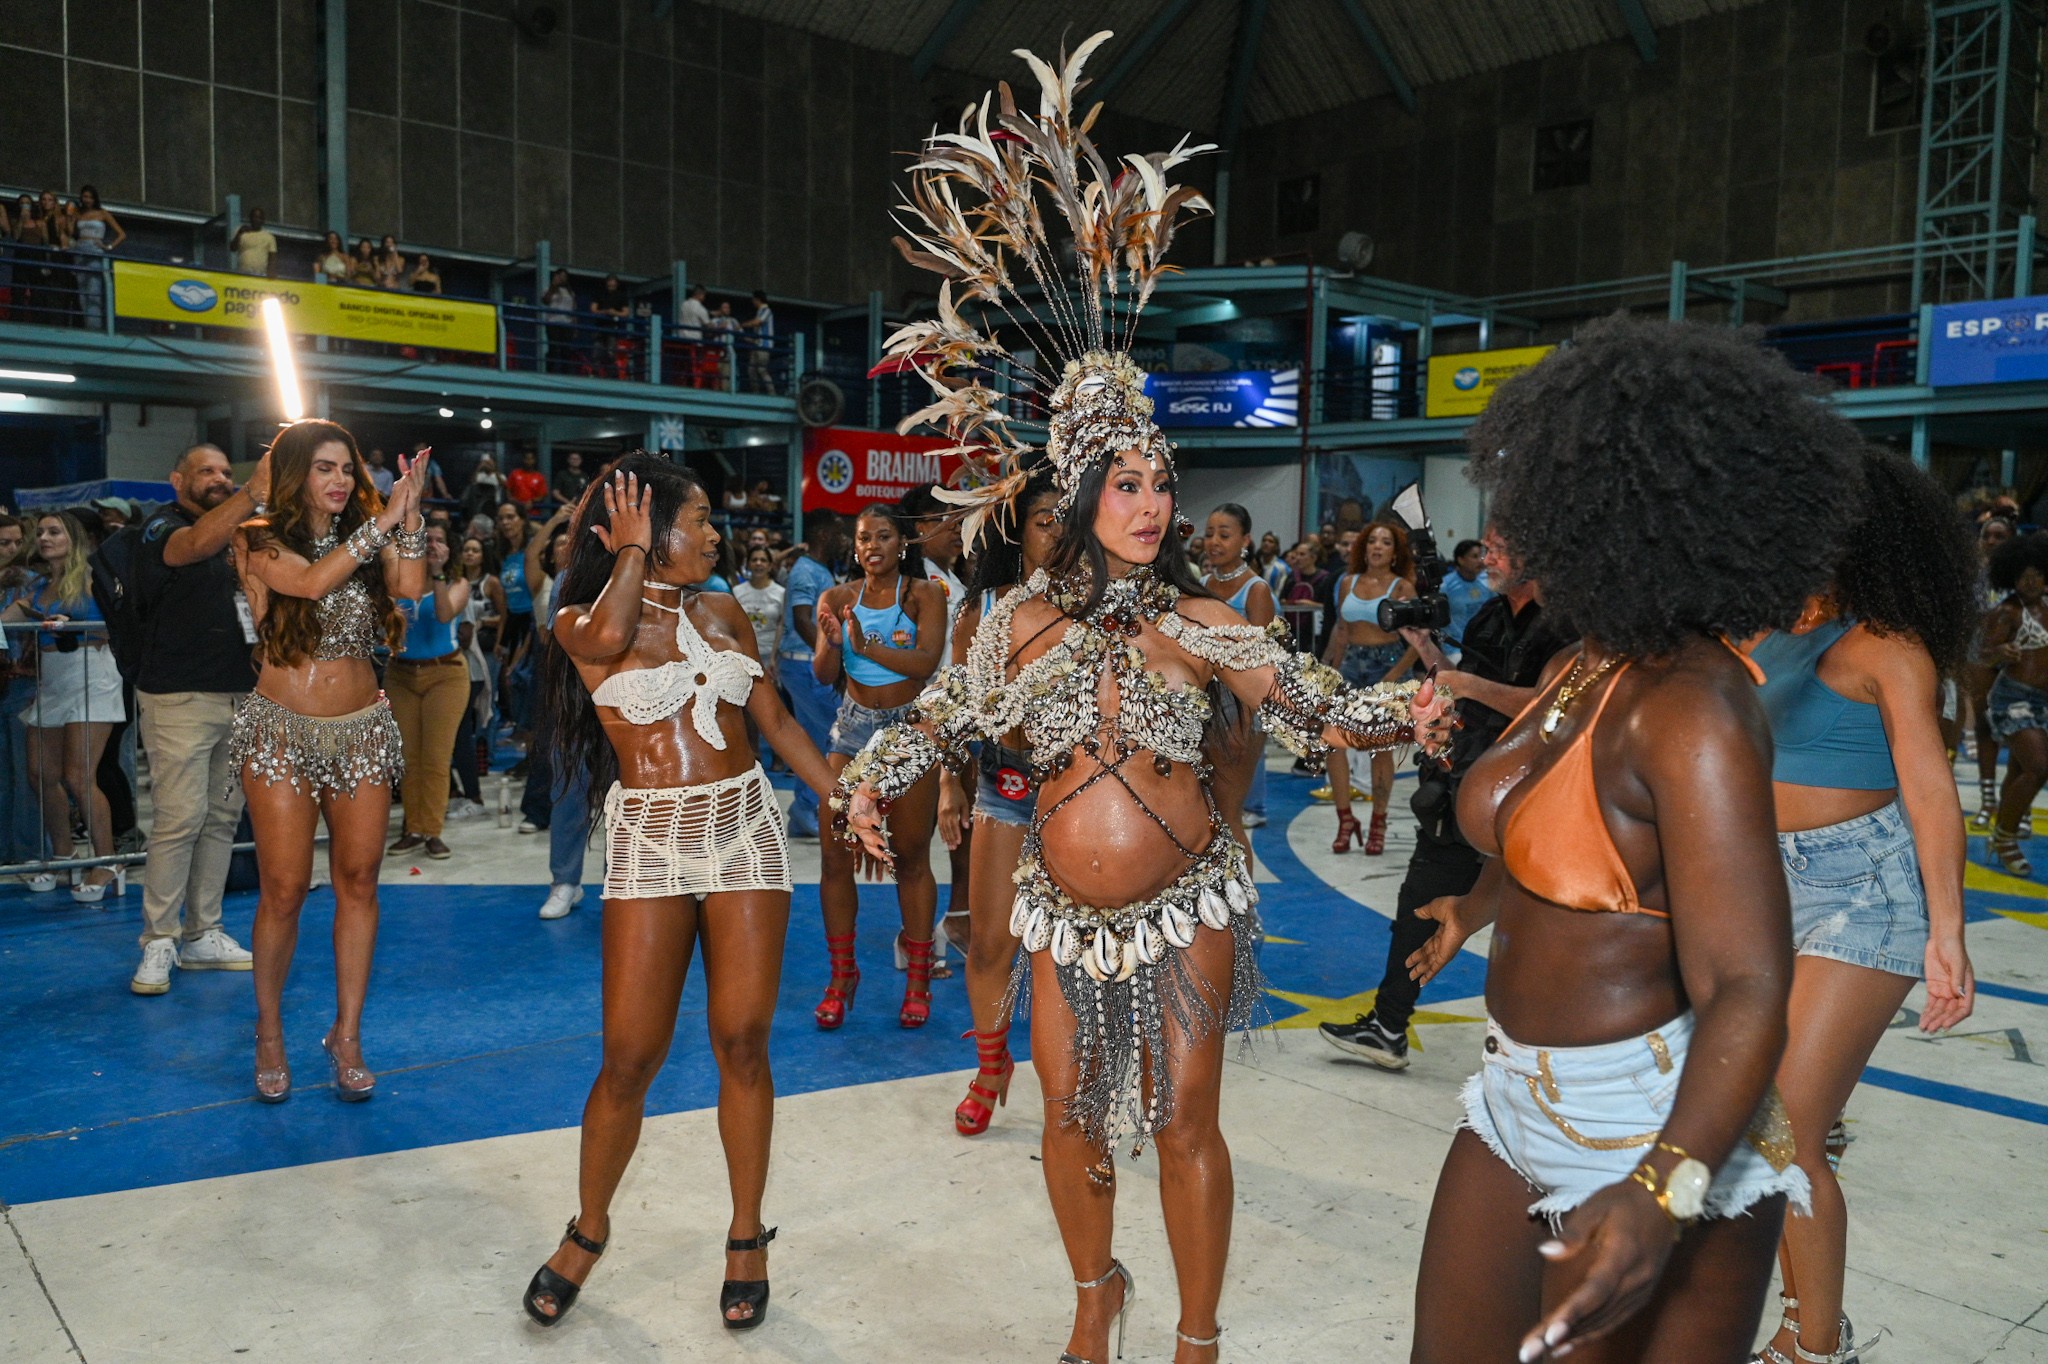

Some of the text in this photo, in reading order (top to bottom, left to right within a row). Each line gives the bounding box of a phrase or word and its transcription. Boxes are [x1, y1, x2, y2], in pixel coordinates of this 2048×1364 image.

[224, 301, 258, 319] pag
[340, 302, 455, 322] BANCO DIGITAL OFICIAL DO
[1213, 402, 1232, 413] RJ
[867, 449, 942, 483] BRAHMA
